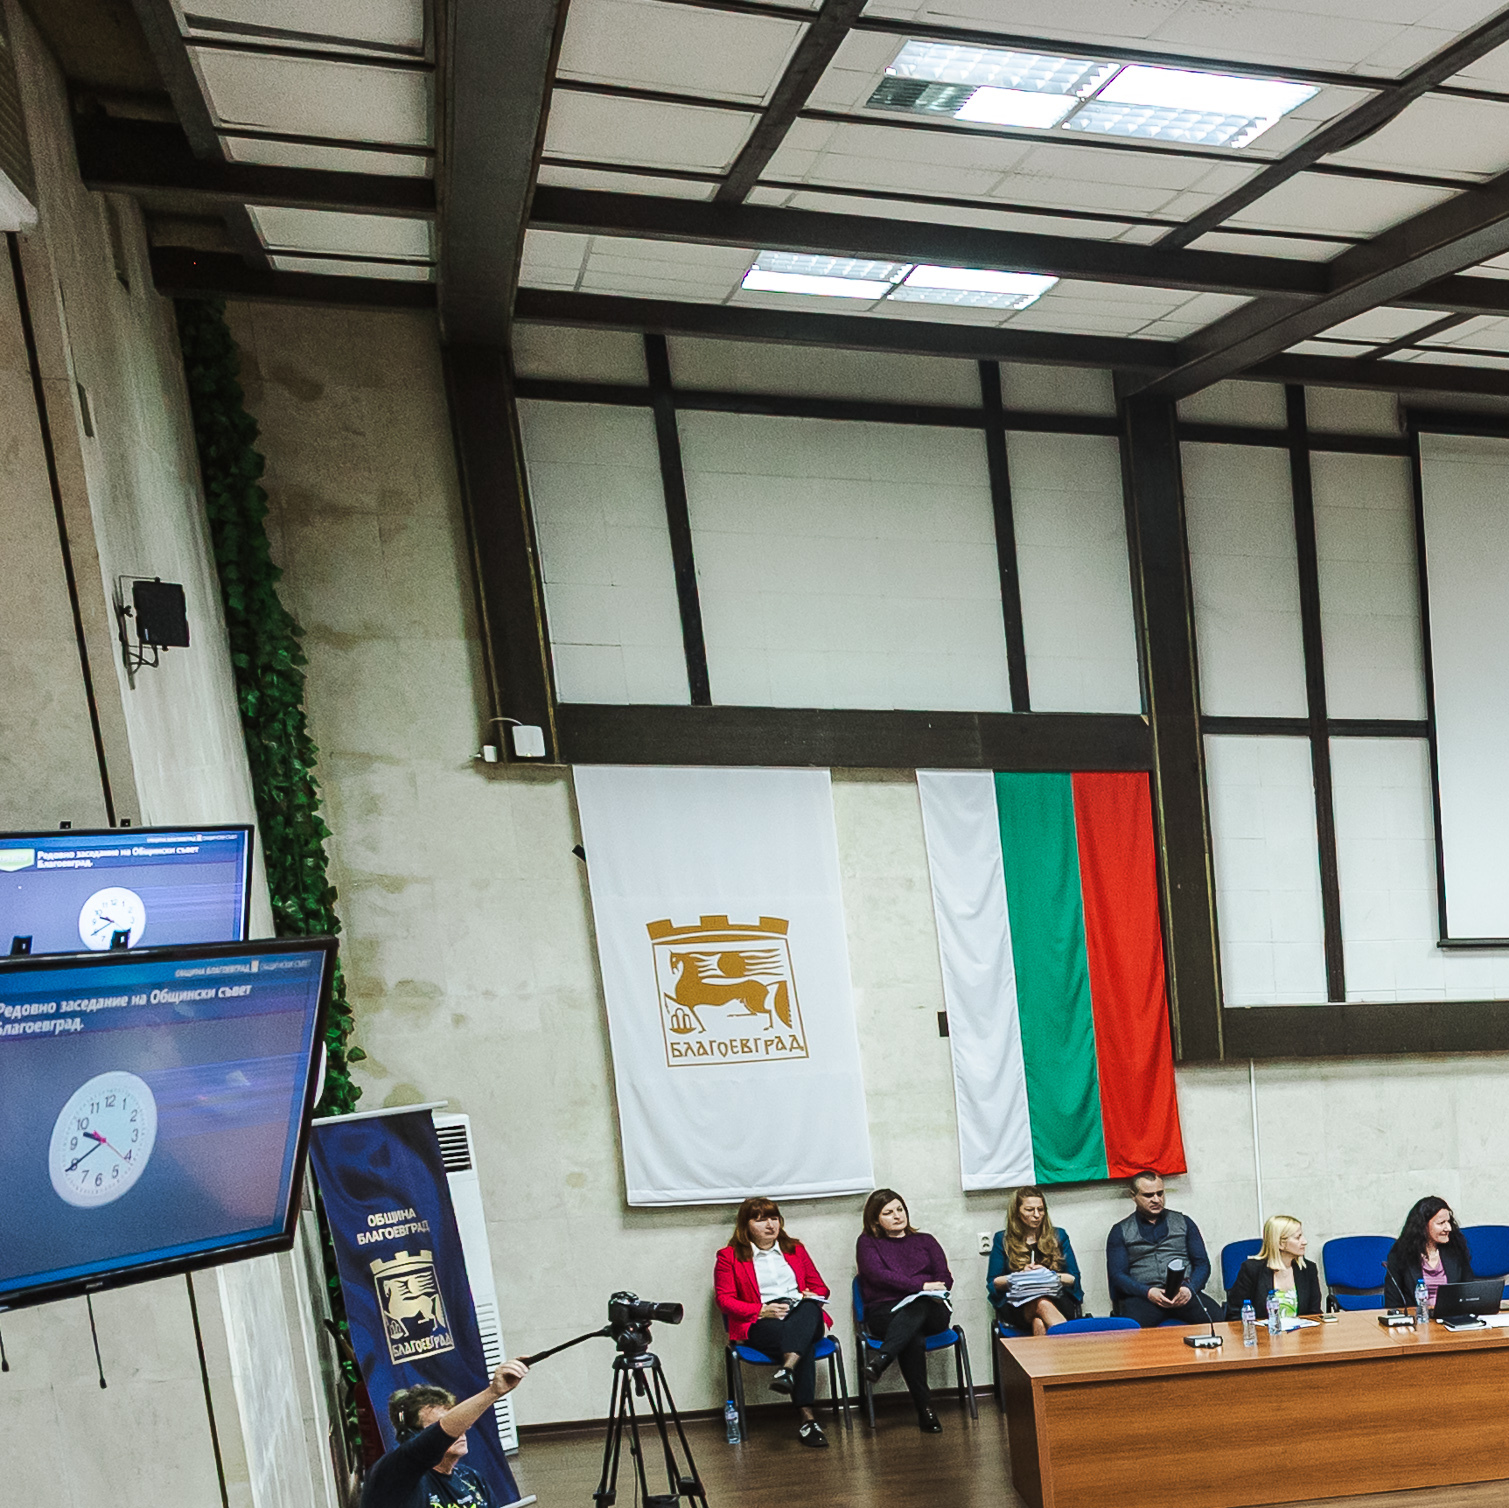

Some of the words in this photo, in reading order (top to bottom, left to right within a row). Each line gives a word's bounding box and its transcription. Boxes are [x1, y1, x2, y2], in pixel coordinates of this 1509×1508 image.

[60, 996, 128, 1012] заседание
[131, 994, 147, 1006] на
[150, 987, 216, 1006] Общински
[218, 985, 252, 998] съвет
[670, 1034, 804, 1057] БЛАГОЕВГРАД
[90, 1102, 100, 1114] 11
[105, 1095, 116, 1108] 12
[122, 1098, 127, 1110] 1
[130, 1109, 138, 1122] 2
[77, 1117, 89, 1130] 10
[131, 1129, 139, 1142] 3
[70, 1136, 78, 1150] 9
[124, 1149, 132, 1161] 4
[82, 1170, 89, 1183] 7
[112, 1164, 119, 1178] 5
[95, 1173, 103, 1186] 6
[367, 1208, 416, 1227] ОБЩИНА
[357, 1220, 430, 1245] БЛАГОЕВГРАД
[392, 1332, 454, 1357] БЛАГОЕВГРАД
